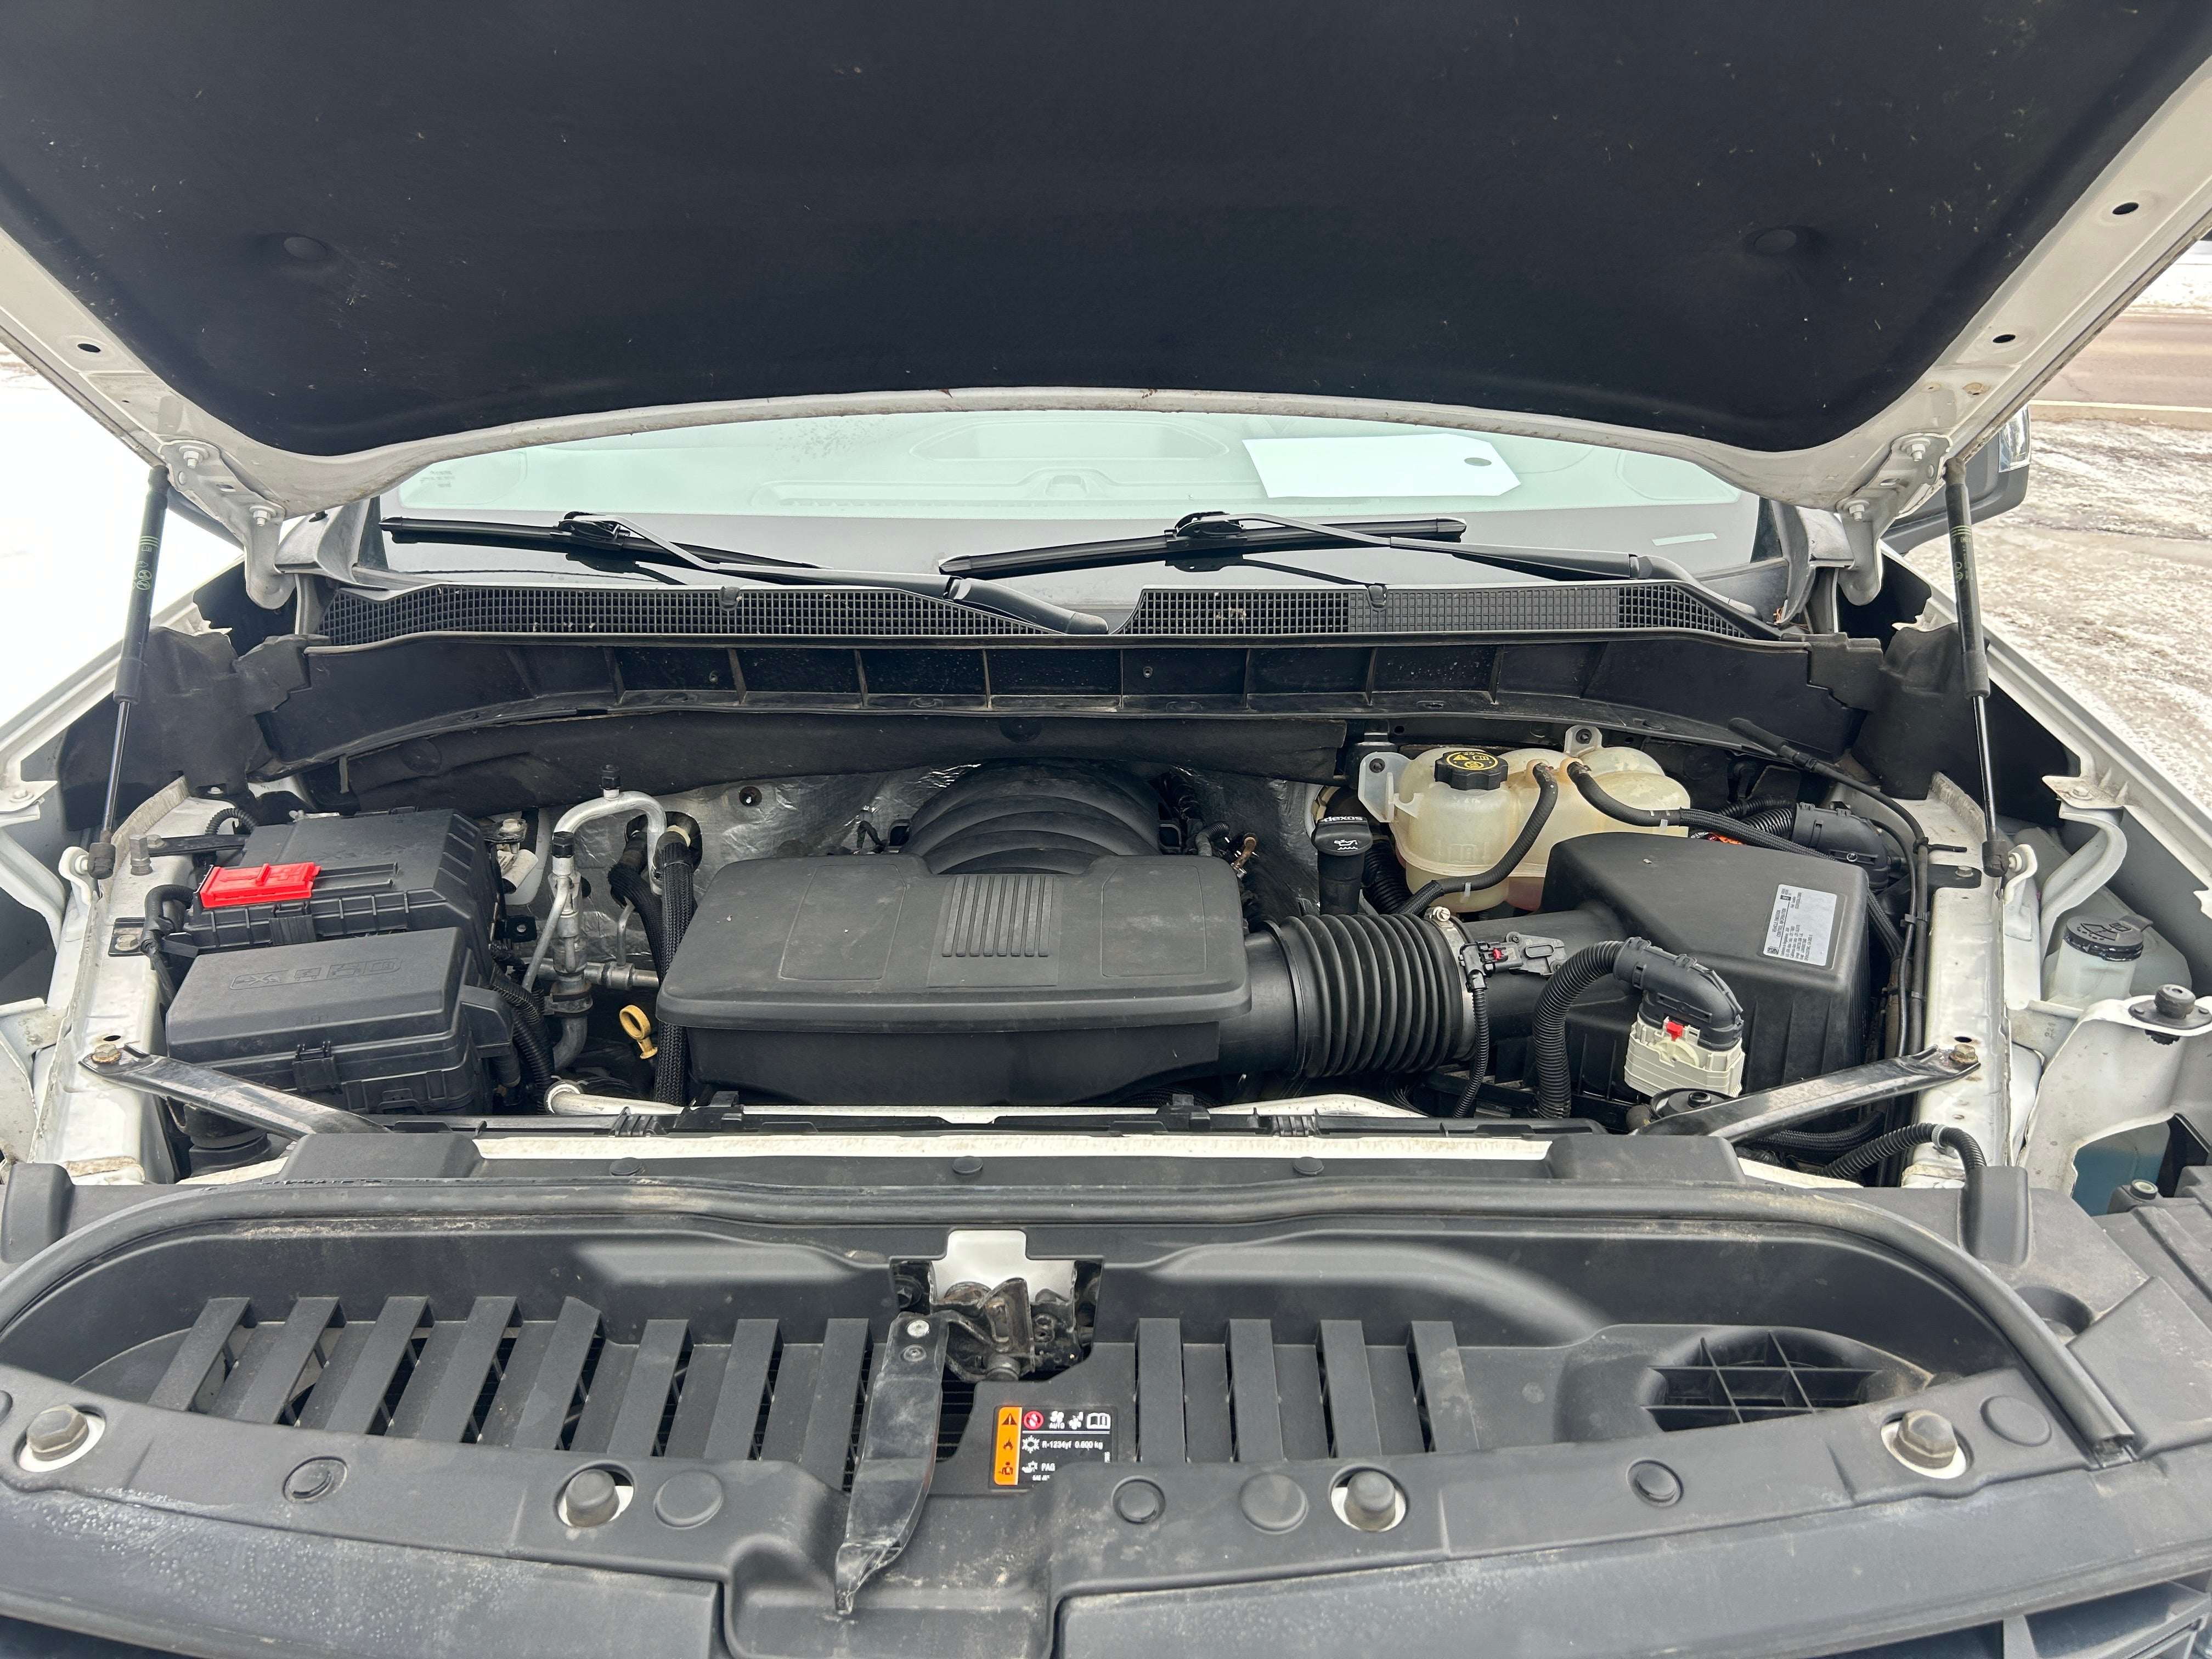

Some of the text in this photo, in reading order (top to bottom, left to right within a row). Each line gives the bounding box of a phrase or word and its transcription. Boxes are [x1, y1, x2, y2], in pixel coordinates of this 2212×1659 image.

[1042, 1440, 1071, 1449] R-1234yf
[1094, 1441, 1103, 1450] kg
[1041, 1463, 1056, 1471] PAG
